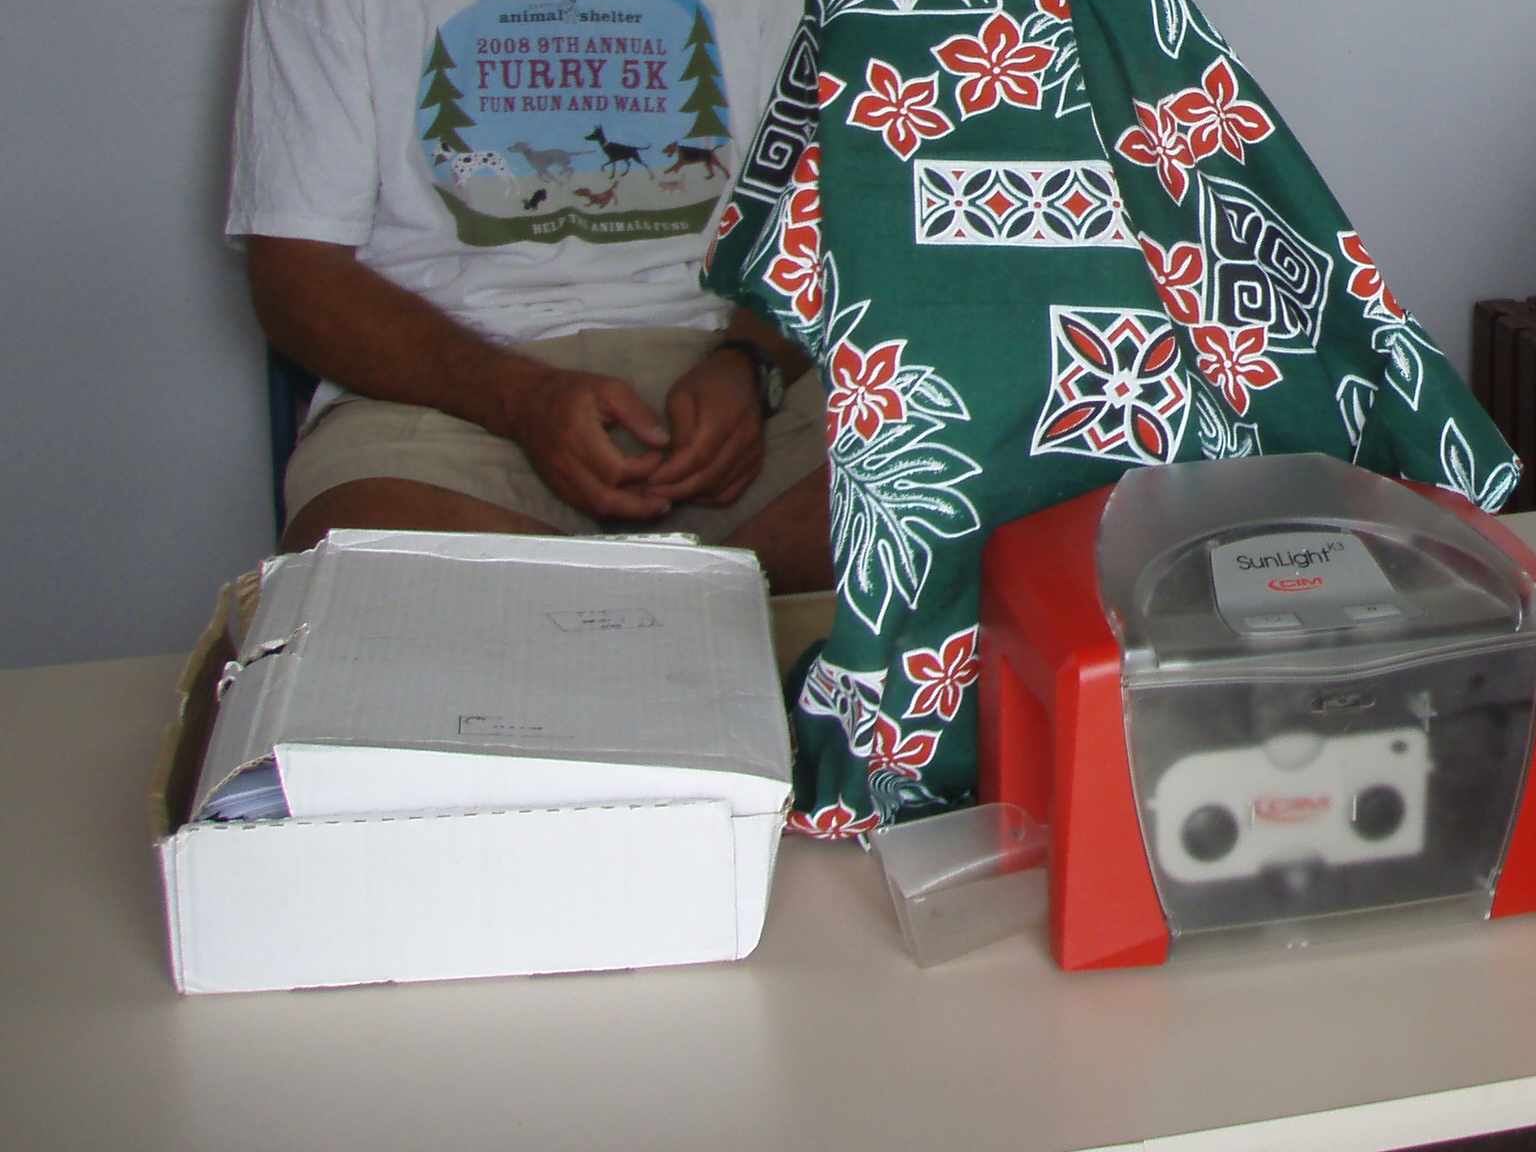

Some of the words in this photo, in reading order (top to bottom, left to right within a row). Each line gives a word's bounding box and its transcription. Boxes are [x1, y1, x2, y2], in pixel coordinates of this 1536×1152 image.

[500, 9, 564, 24] animal
[579, 9, 643, 24] shelter
[476, 37, 531, 55] 2008
[537, 36, 580, 54] 9TH
[585, 37, 668, 56] ANNUAL
[476, 58, 608, 90] FURRY
[621, 59, 669, 90] 5K
[479, 95, 516, 113] FUN
[521, 95, 563, 112] RUN
[567, 95, 611, 112] AND
[614, 95, 668, 114] WALK
[590, 219, 652, 233] ANIMALS
[1235, 547, 1331, 571] SunLight
